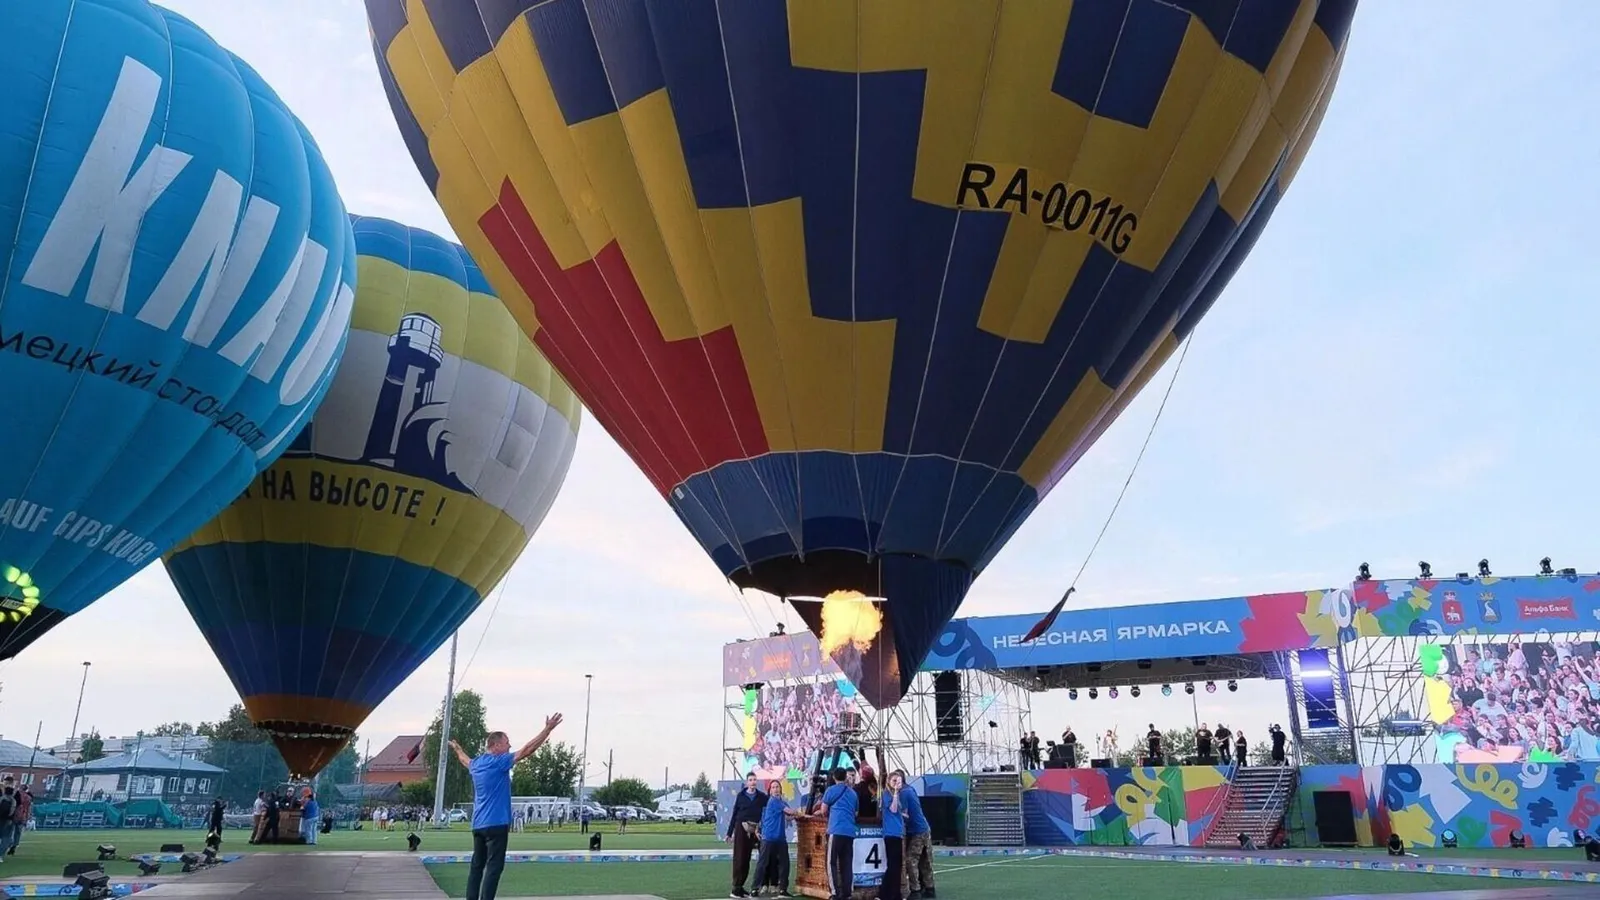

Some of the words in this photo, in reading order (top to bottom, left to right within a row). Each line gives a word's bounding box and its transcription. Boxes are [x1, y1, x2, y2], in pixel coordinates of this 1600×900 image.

[956, 163, 1137, 254] RA-0011G
[21, 55, 355, 459] KNAU
[261, 469, 297, 501] НА
[309, 470, 425, 519] ВЫСОТЕ
[0, 498, 54, 533] AUF
[52, 510, 113, 548] GIPS
[1117, 619, 1231, 641] ЯРМАРКА
[864, 843, 882, 869] 4
